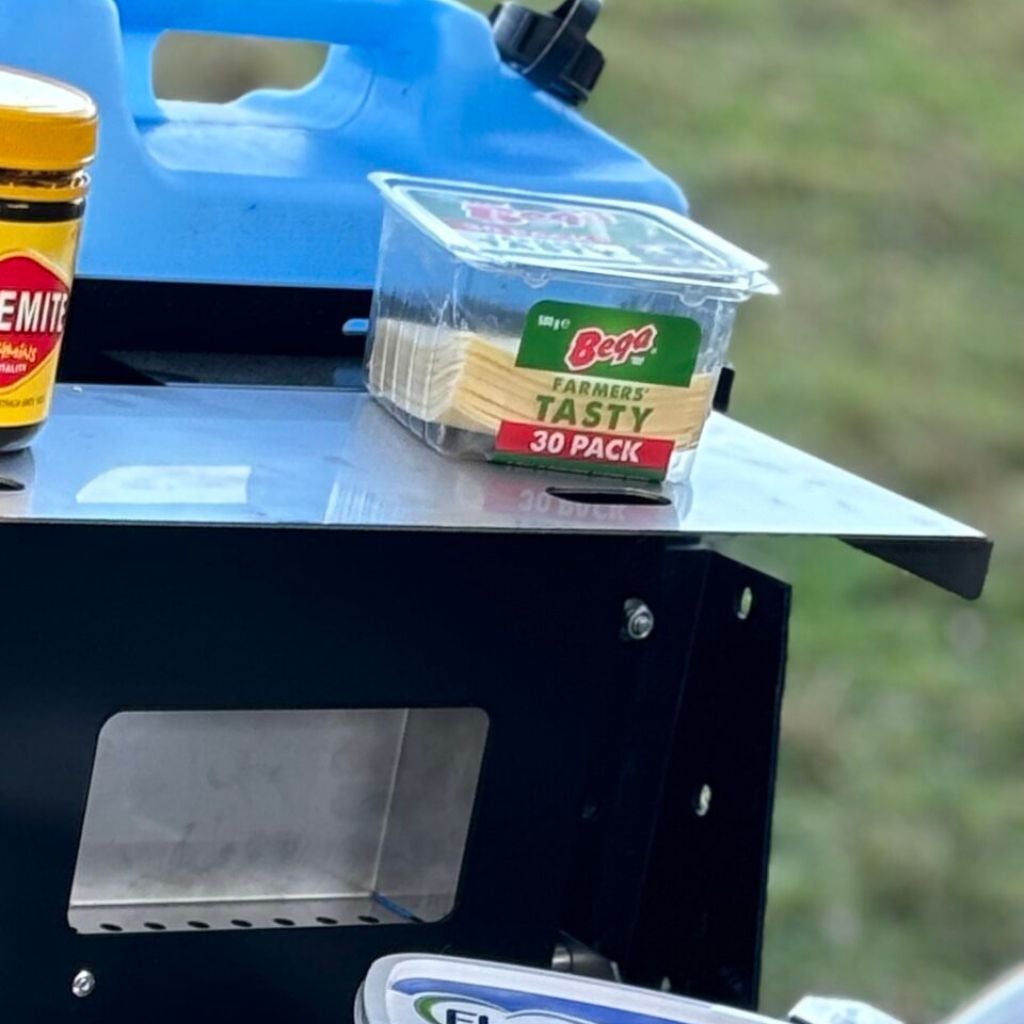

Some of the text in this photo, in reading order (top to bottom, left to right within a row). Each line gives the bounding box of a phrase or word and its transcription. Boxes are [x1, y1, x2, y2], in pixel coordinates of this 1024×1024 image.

[564, 324, 658, 371] Bega
[552, 377, 649, 401] FARMERS'
[536, 394, 654, 433] TASTY
[530, 430, 644, 463] 30 PACK
